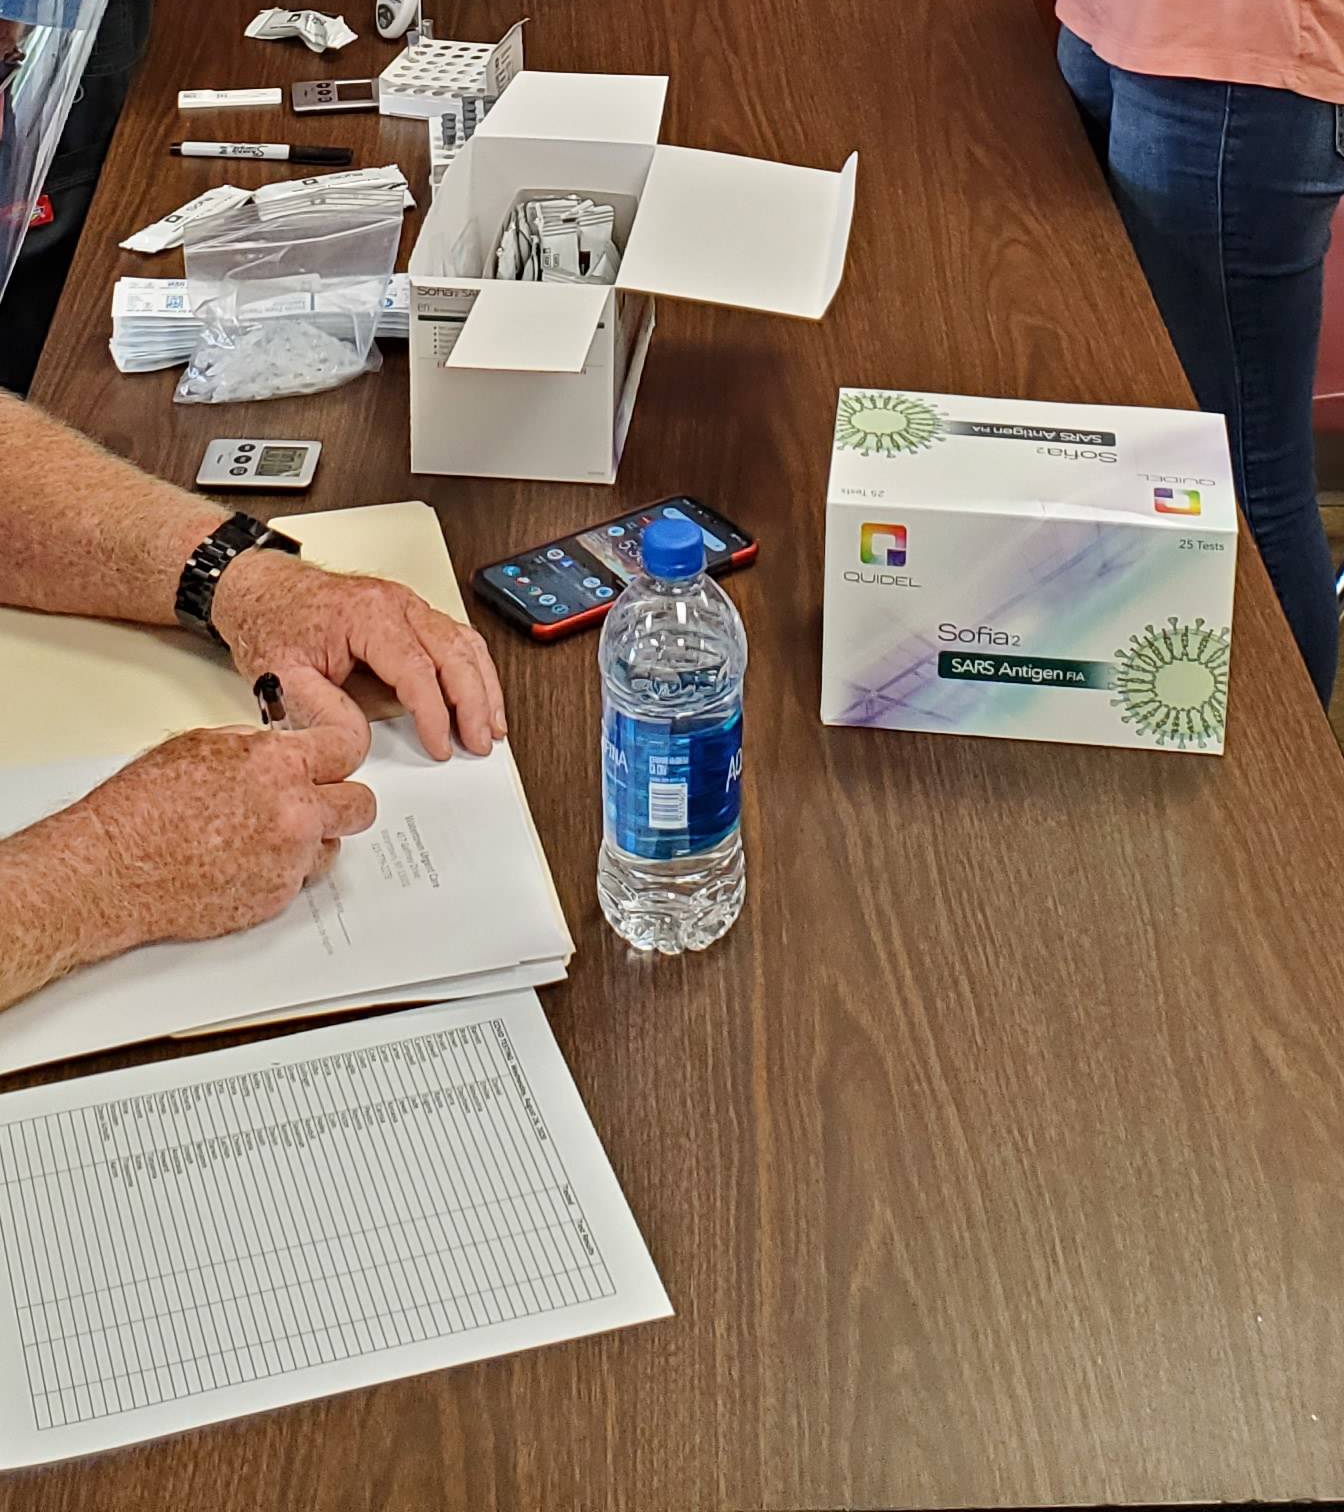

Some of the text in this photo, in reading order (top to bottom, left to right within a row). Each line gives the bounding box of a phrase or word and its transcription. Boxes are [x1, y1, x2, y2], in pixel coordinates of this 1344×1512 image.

[993, 425, 1057, 441] Antigen
[1059, 431, 1103, 444] SARS
[1177, 538, 1226, 552] 25 Tests
[843, 571, 923, 588] QUIDEL
[951, 657, 1087, 683] SARS Antigen FIA
